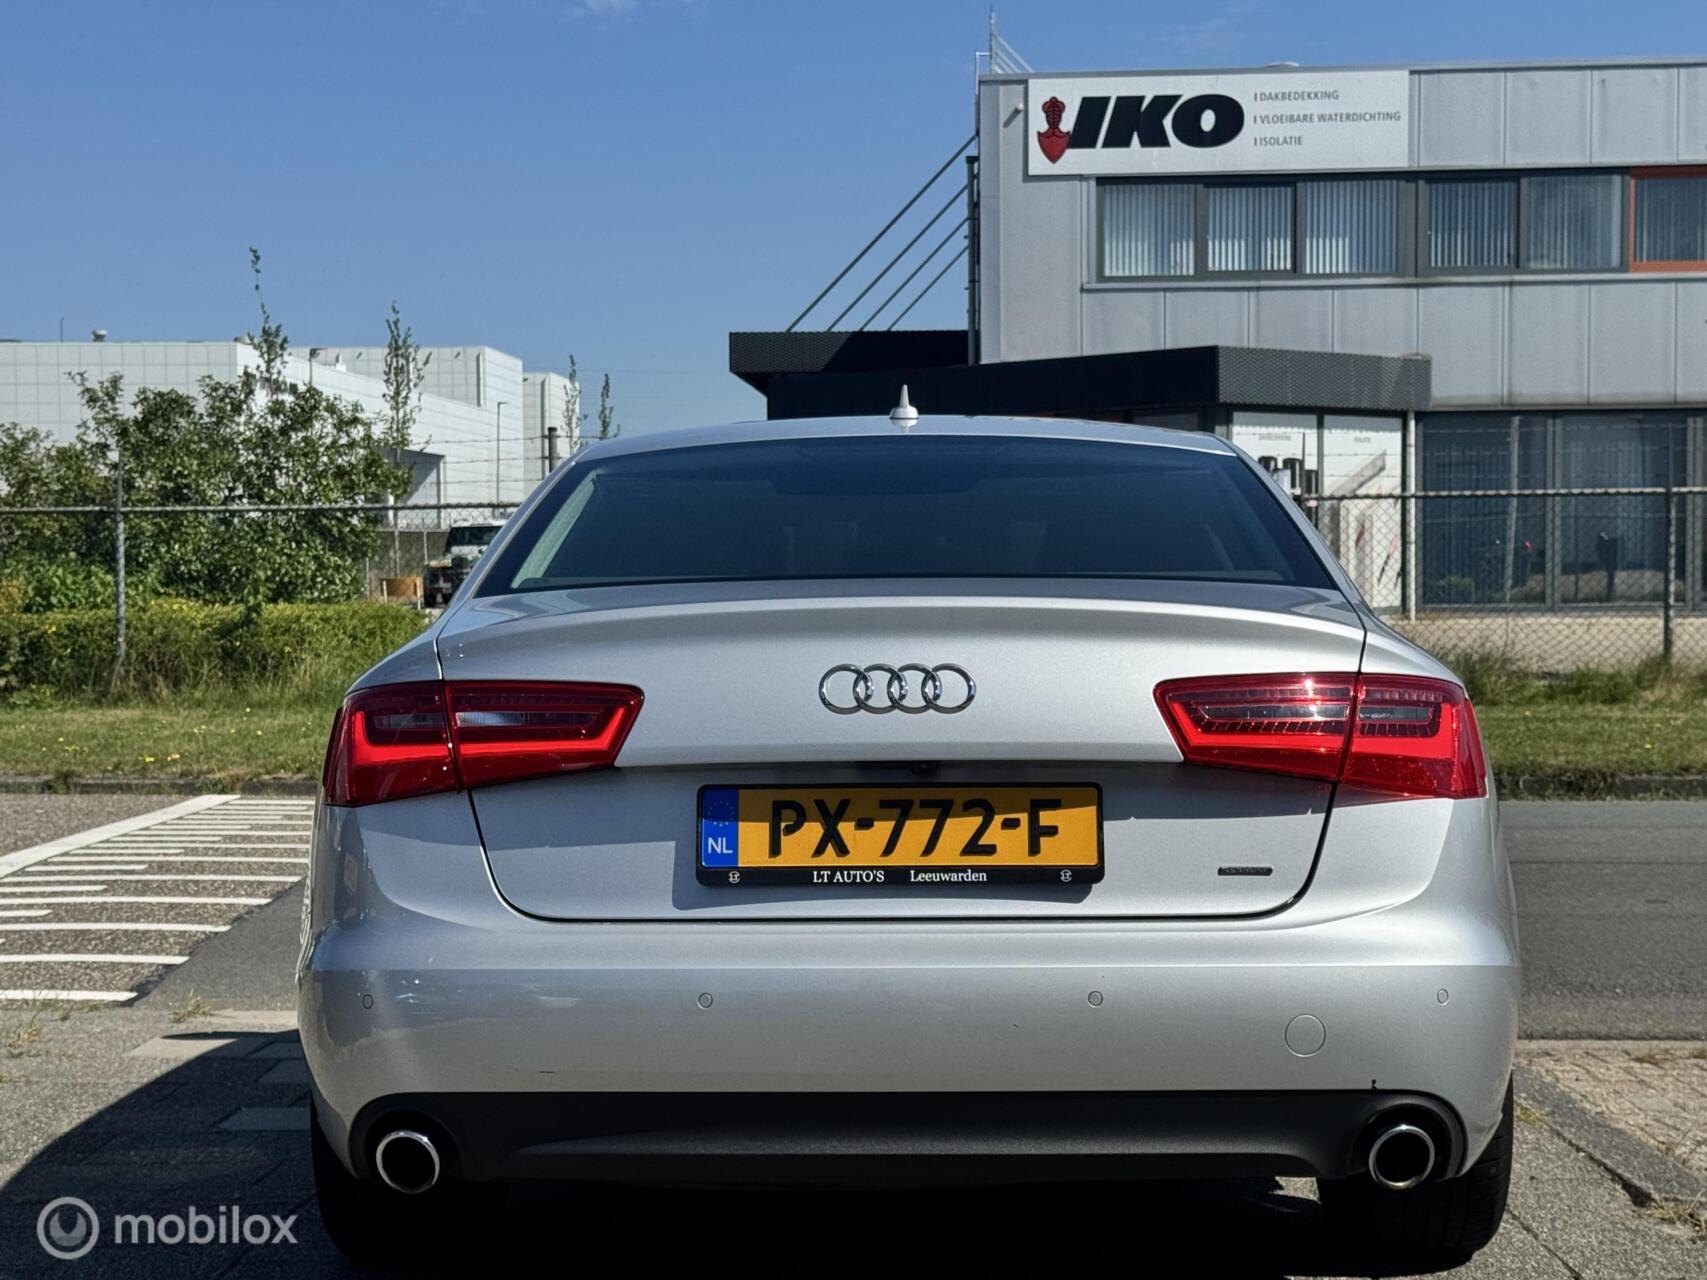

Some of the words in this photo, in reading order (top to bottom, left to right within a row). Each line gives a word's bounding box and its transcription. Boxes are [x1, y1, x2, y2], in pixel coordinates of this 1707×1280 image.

[1259, 90, 1340, 102] DAKBEDEKKING
[1067, 94, 1245, 149] IKO
[1259, 113, 1315, 125] VLOEIBARE
[1317, 111, 1401, 123] WATERDICHTING
[1259, 136, 1303, 147] ISOLATIE
[769, 799, 1062, 858] PX-772-F
[708, 837, 734, 854] NL
[813, 871, 831, 883] LT
[833, 870, 885, 883] AUTO'S
[910, 869, 988, 882] Leeuwarden
